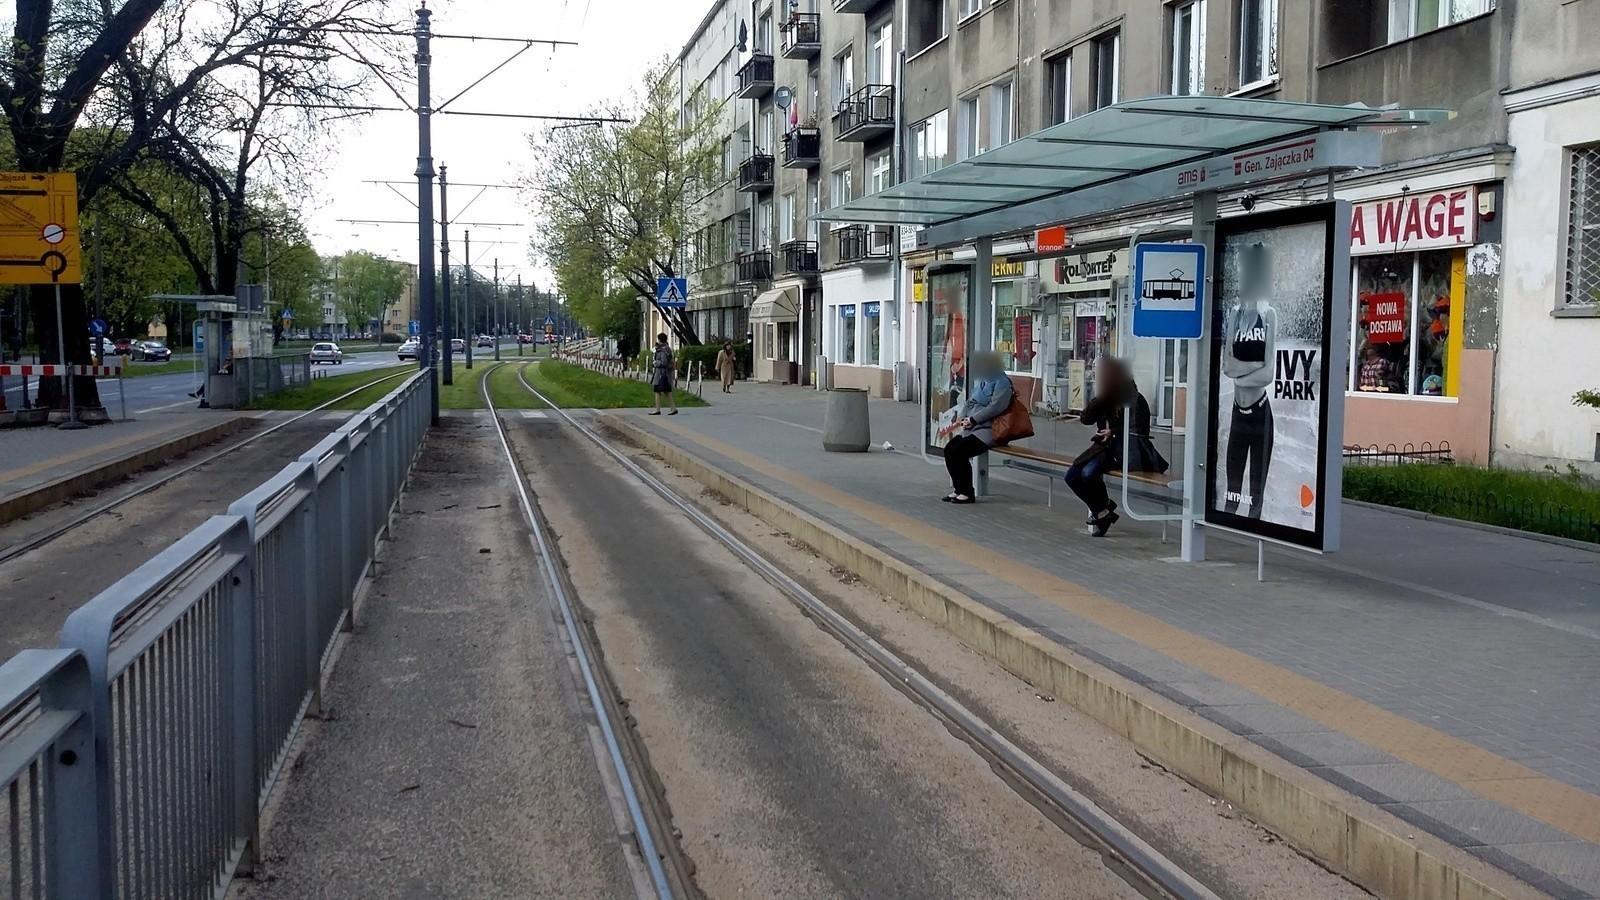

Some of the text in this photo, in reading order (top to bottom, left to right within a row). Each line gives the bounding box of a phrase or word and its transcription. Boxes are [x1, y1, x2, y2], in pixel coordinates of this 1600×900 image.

[1244, 161, 1263, 173] Gen.
[1265, 151, 1301, 171] Zajączka
[1303, 148, 1314, 161] 04
[1178, 171, 1198, 185] ams
[1376, 191, 1467, 244] WAGĘ
[1376, 302, 1398, 316] NOWA
[1370, 320, 1403, 334] DOSTAWA
[1276, 350, 1317, 381] IVY
[1274, 380, 1316, 400] PARK
